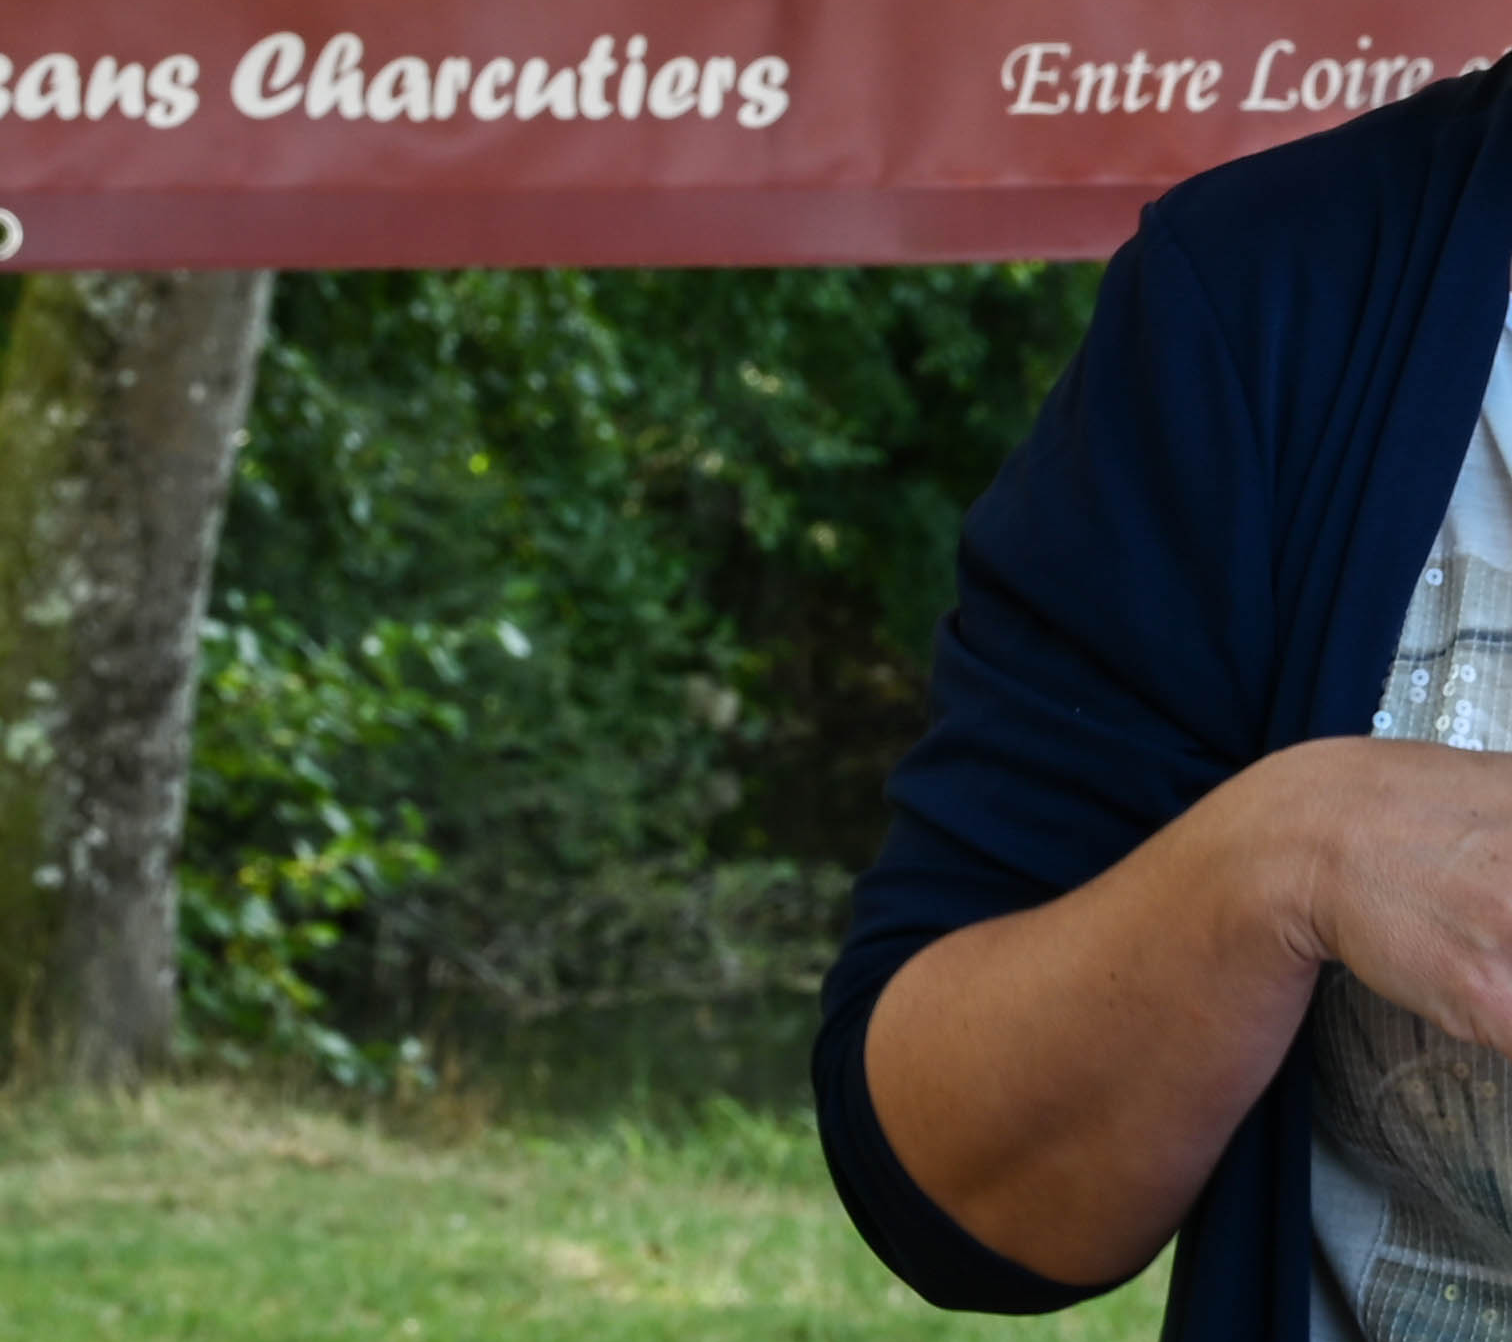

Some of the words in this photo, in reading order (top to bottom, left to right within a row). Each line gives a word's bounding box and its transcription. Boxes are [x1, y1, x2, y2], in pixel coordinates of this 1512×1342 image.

[230, 33, 790, 130] Charcutiers
[1002, 42, 1220, 115] Entre
[1241, 38, 1434, 112] Loire
